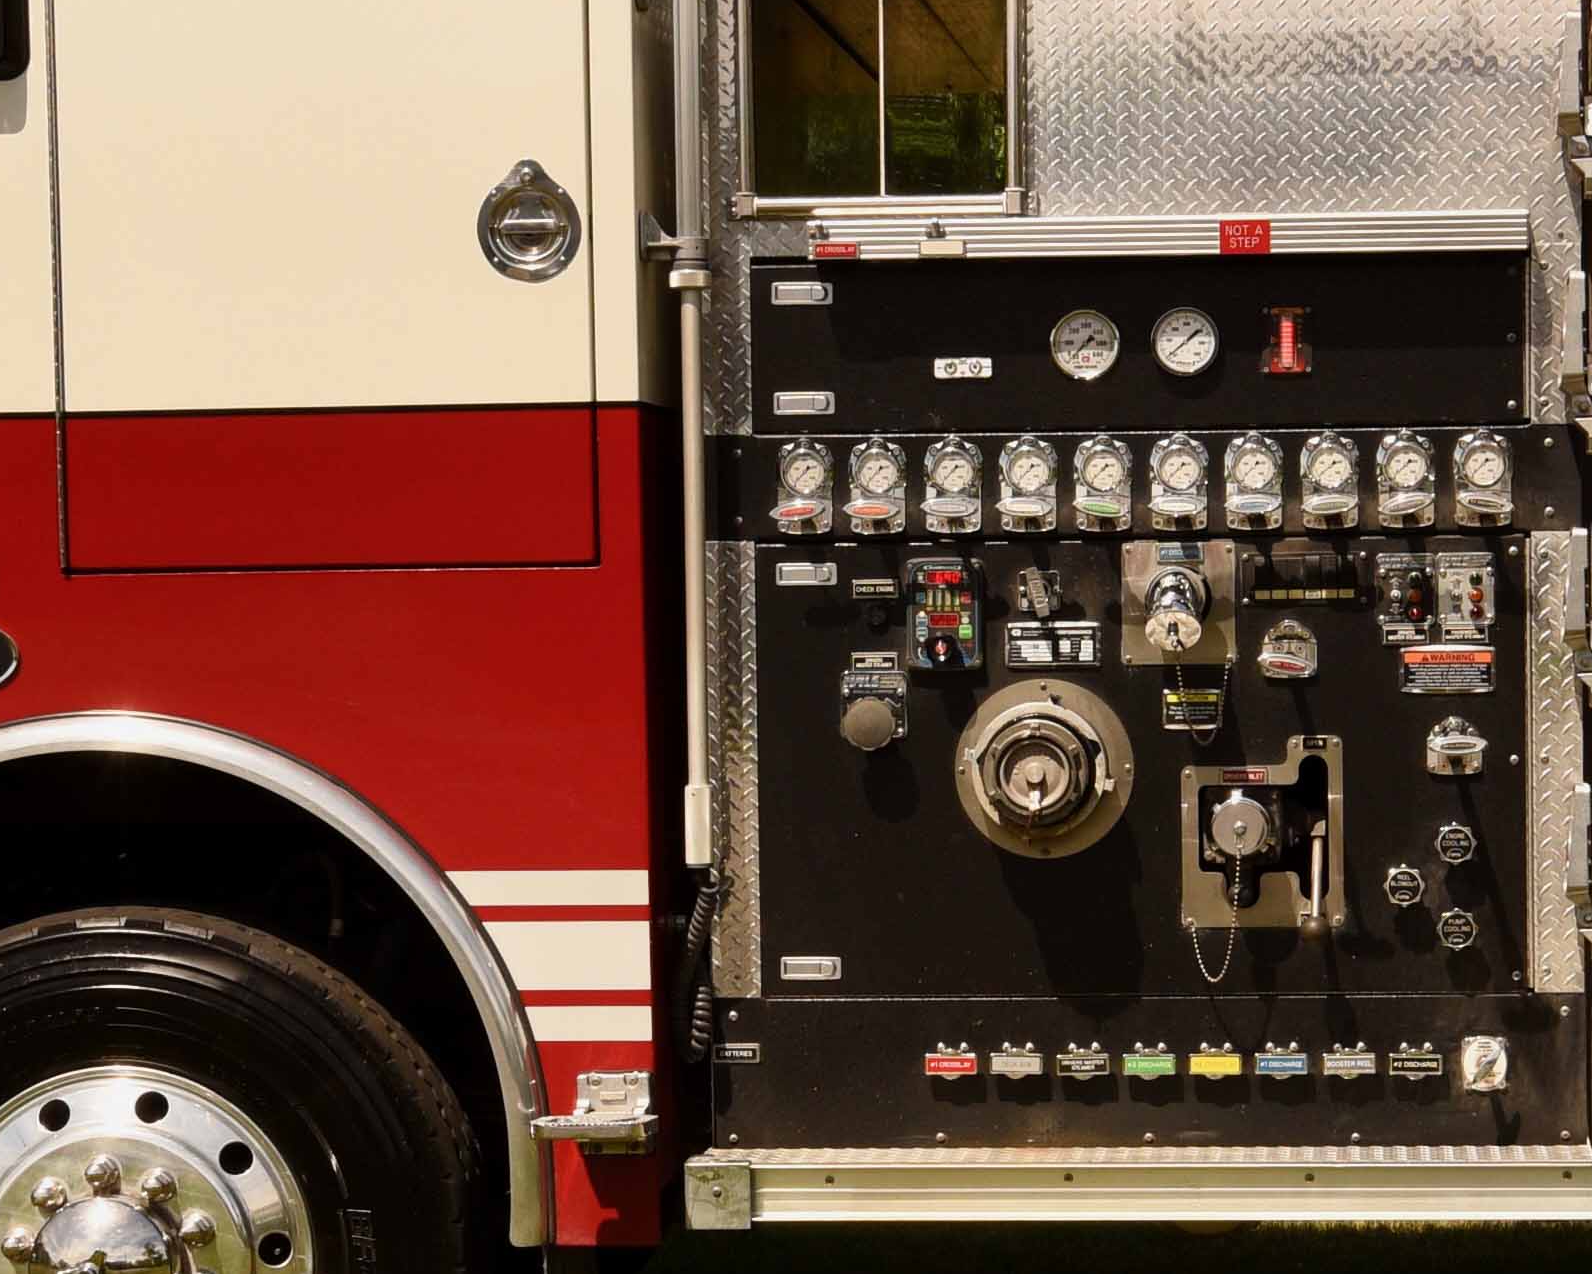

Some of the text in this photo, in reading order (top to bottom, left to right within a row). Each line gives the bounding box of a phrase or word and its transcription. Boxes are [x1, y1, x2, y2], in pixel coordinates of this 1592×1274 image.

[1224, 224, 1263, 236] NOT A
[1229, 237, 1260, 248] STEP
[855, 585, 894, 593] CHECK ENGINE
[1430, 653, 1476, 661] WARNING
